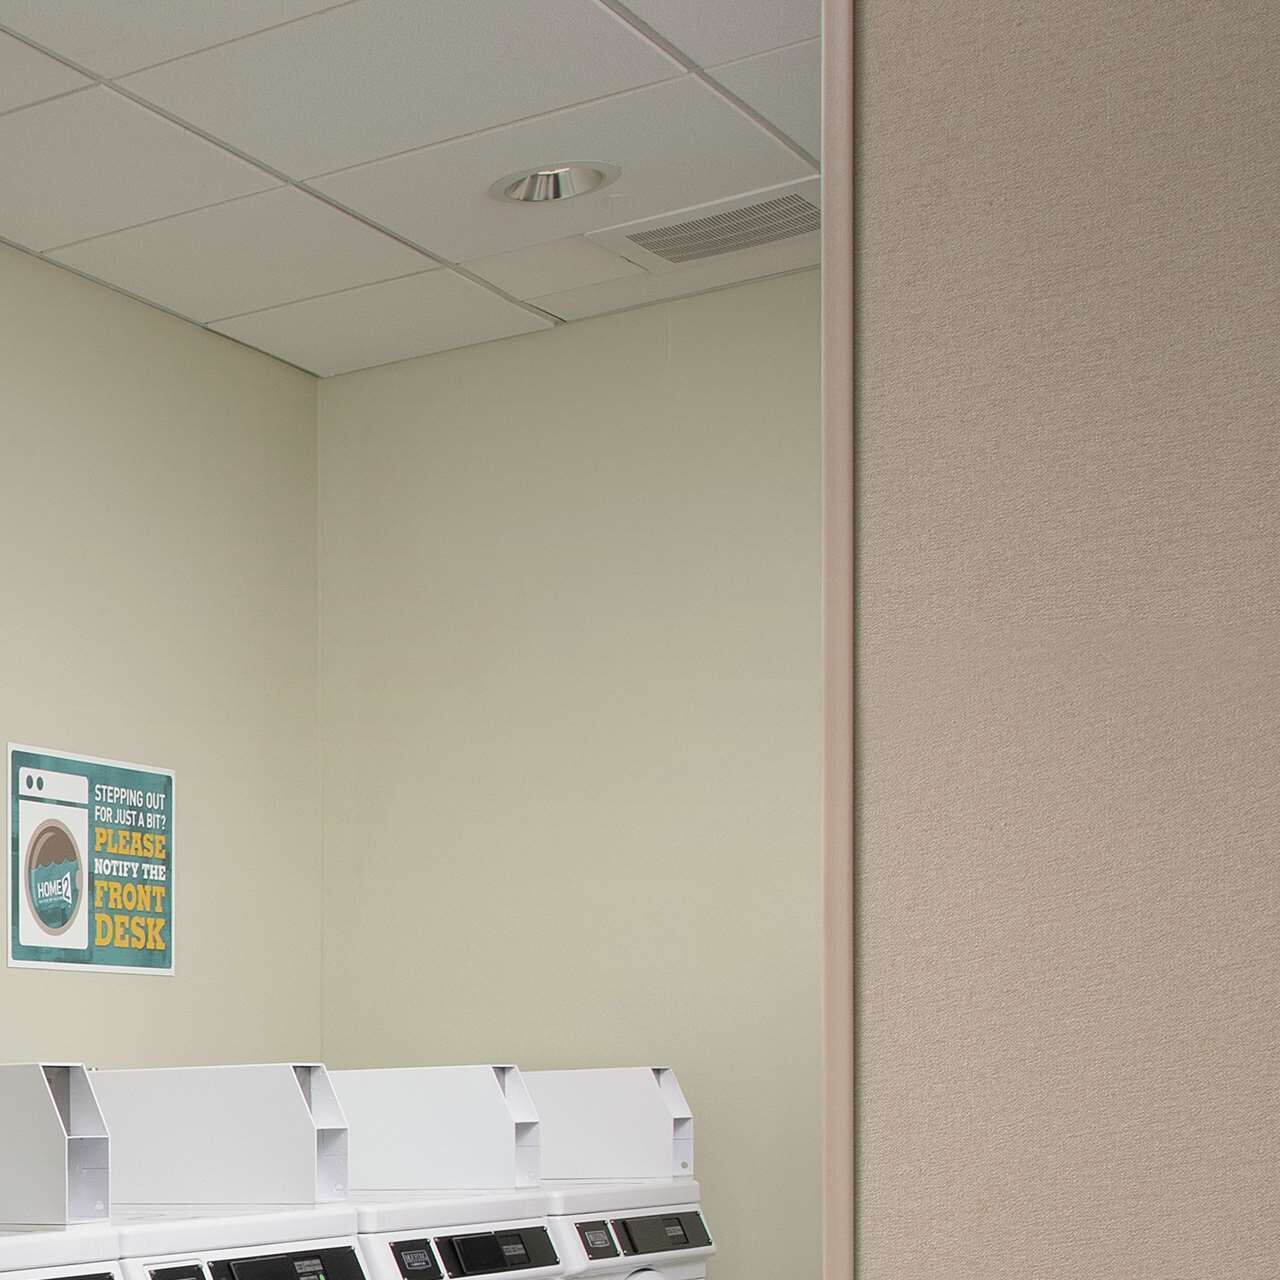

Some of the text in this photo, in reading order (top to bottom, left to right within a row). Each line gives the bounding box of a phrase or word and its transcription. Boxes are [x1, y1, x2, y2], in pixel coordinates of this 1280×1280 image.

[94, 784, 165, 810] STEPPING OUT
[94, 806, 166, 830] FOR JUST A BIT?
[94, 827, 167, 860] PLEASE
[94, 858, 166, 881] NOTIFY THE
[94, 881, 166, 914] FRONT
[94, 914, 167, 950] DESK
